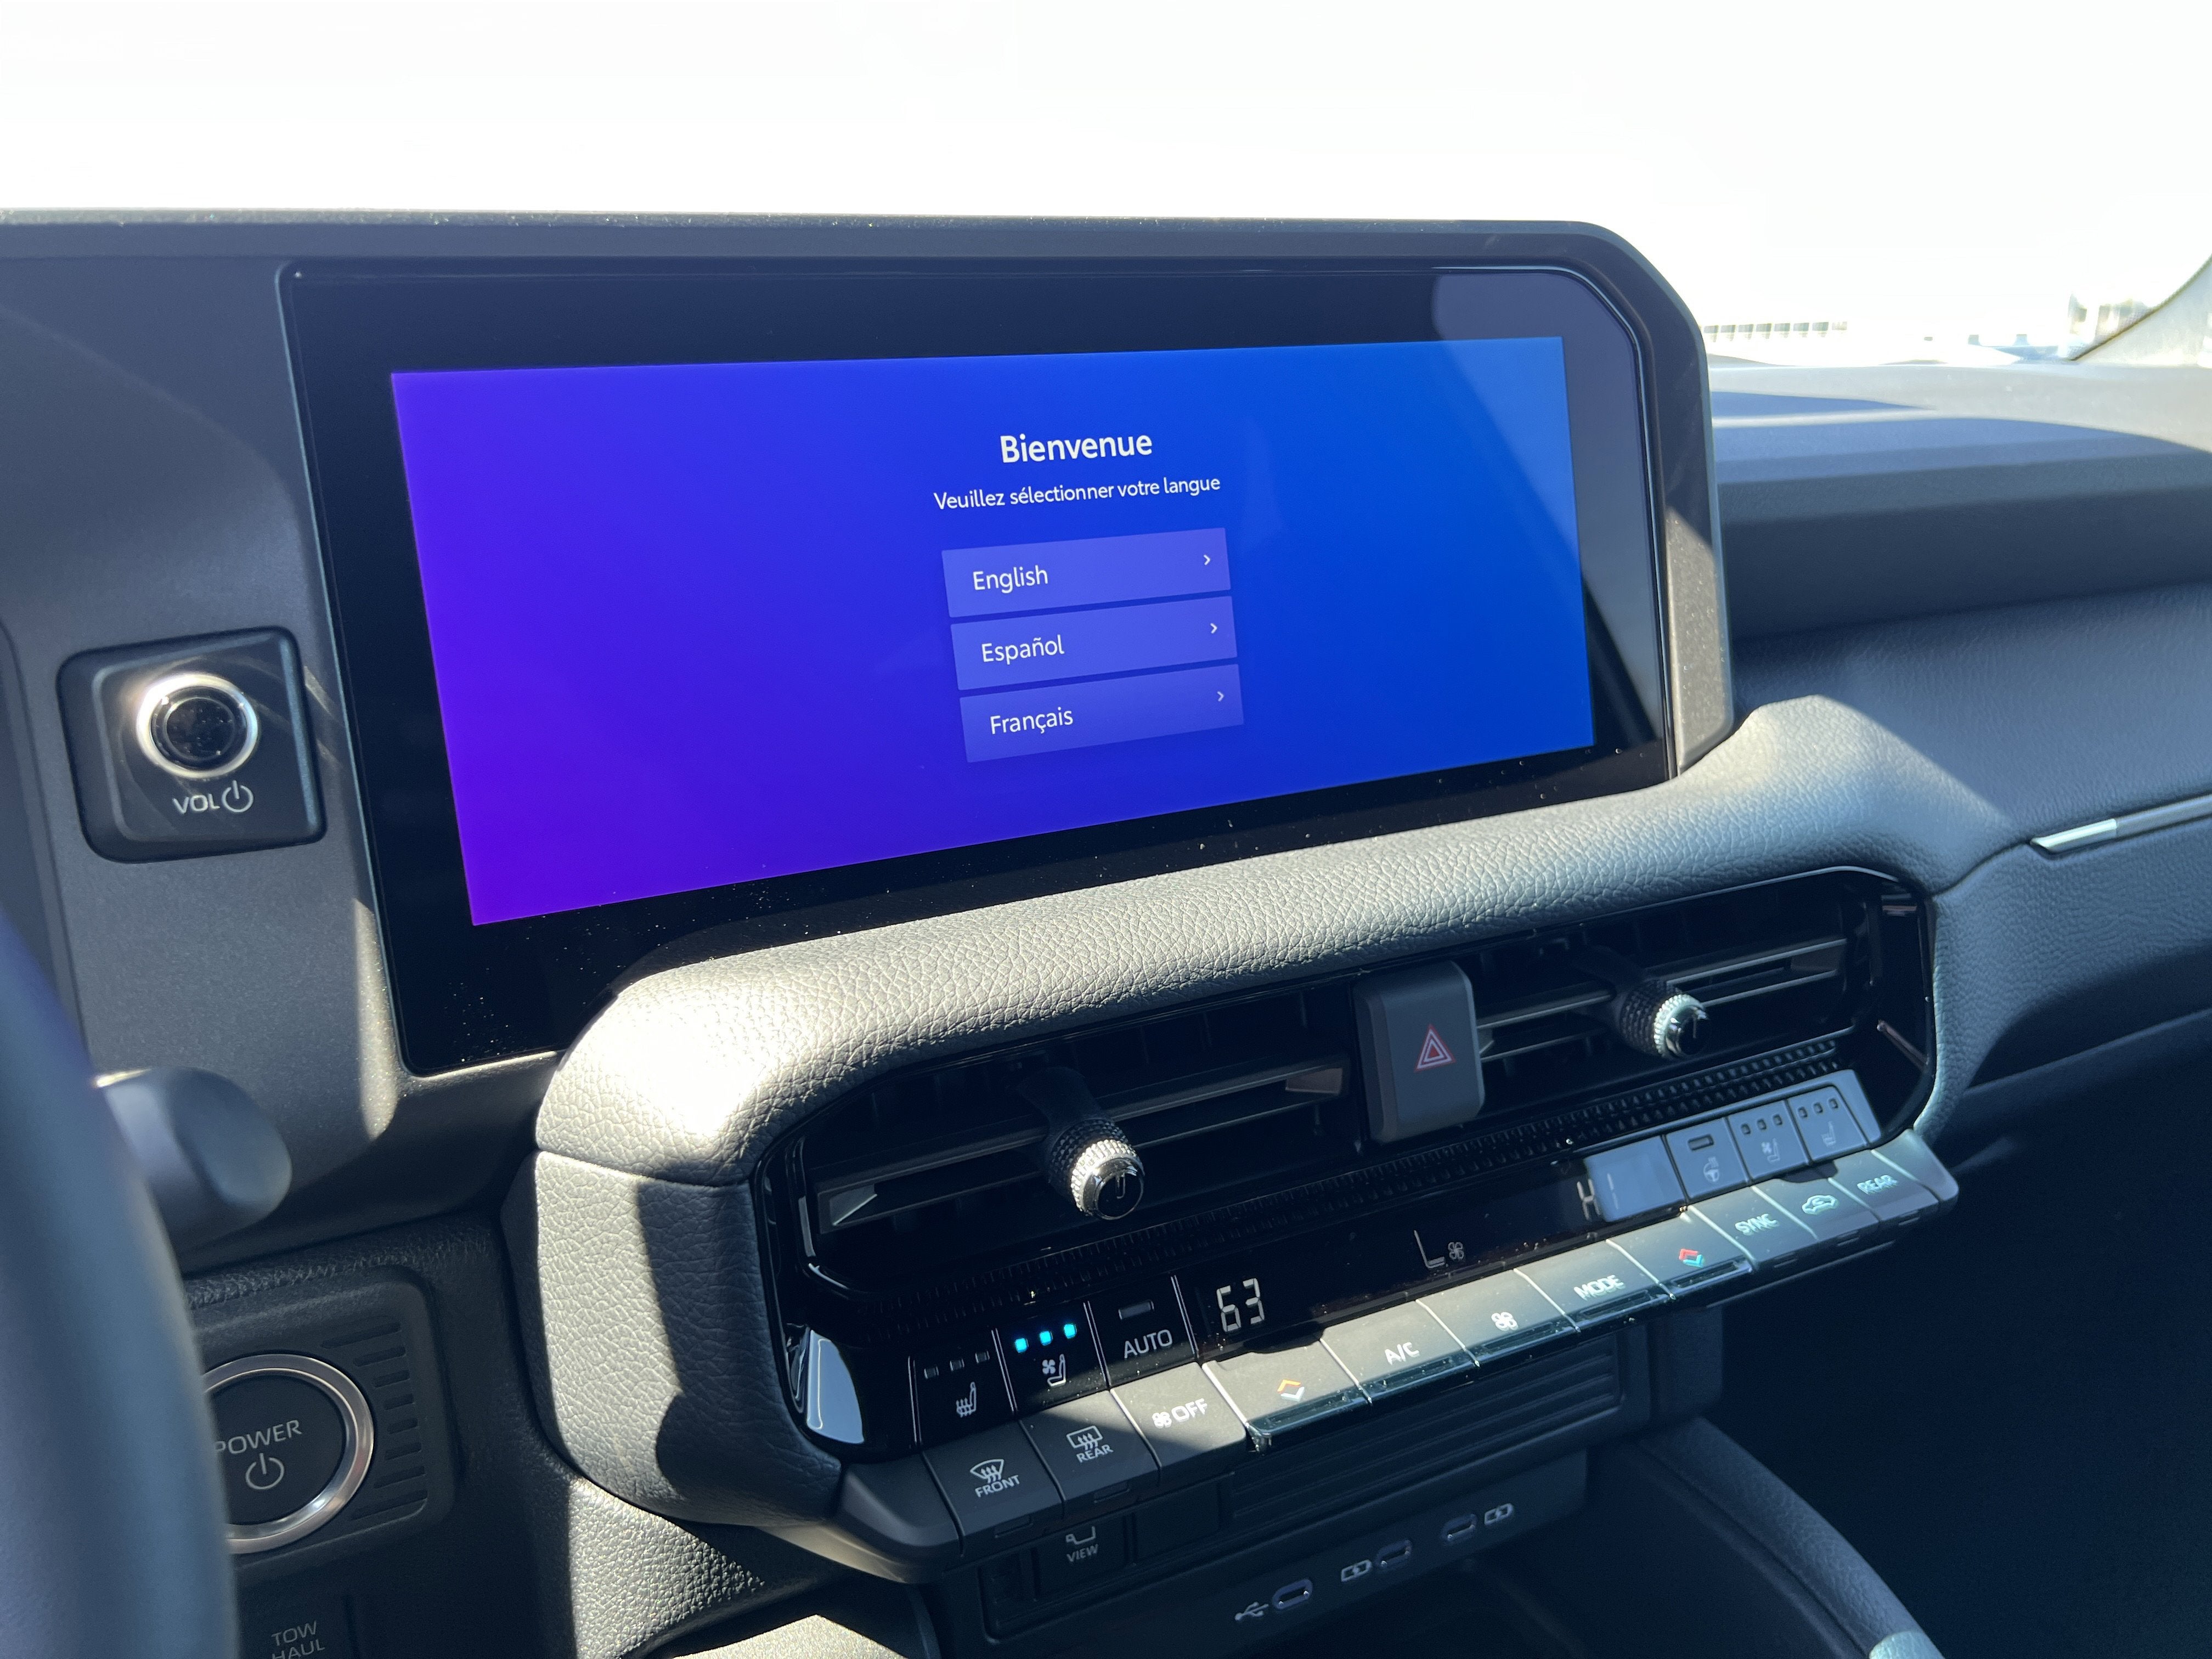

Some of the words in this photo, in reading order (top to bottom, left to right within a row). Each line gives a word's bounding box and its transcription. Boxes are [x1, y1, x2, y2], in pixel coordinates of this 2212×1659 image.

[1000, 433, 1153, 463] Bienvenue
[934, 490, 1005, 509] Veuillez
[1010, 484, 1114, 505] sélectionner
[1118, 482, 1159, 497] votre
[1164, 477, 1221, 496] langue
[973, 566, 1048, 594] English
[981, 635, 1064, 664] Español
[990, 707, 1073, 734] Français
[172, 794, 220, 815] VOL
[1857, 1175, 1898, 1194] REAR
[1735, 1213, 1779, 1235] SYNC
[1573, 1274, 1625, 1301] MODE
[1216, 1278, 1265, 1333] 63
[1124, 1329, 1173, 1359] AUTO
[1385, 1341, 1420, 1364] A/C
[1171, 1398, 1208, 1423] OFF
[1076, 1444, 1114, 1463] REAR
[974, 1474, 1020, 1498] FRONT
[1066, 1543, 1099, 1563] VIEW
[271, 1620, 317, 1646] TOW
